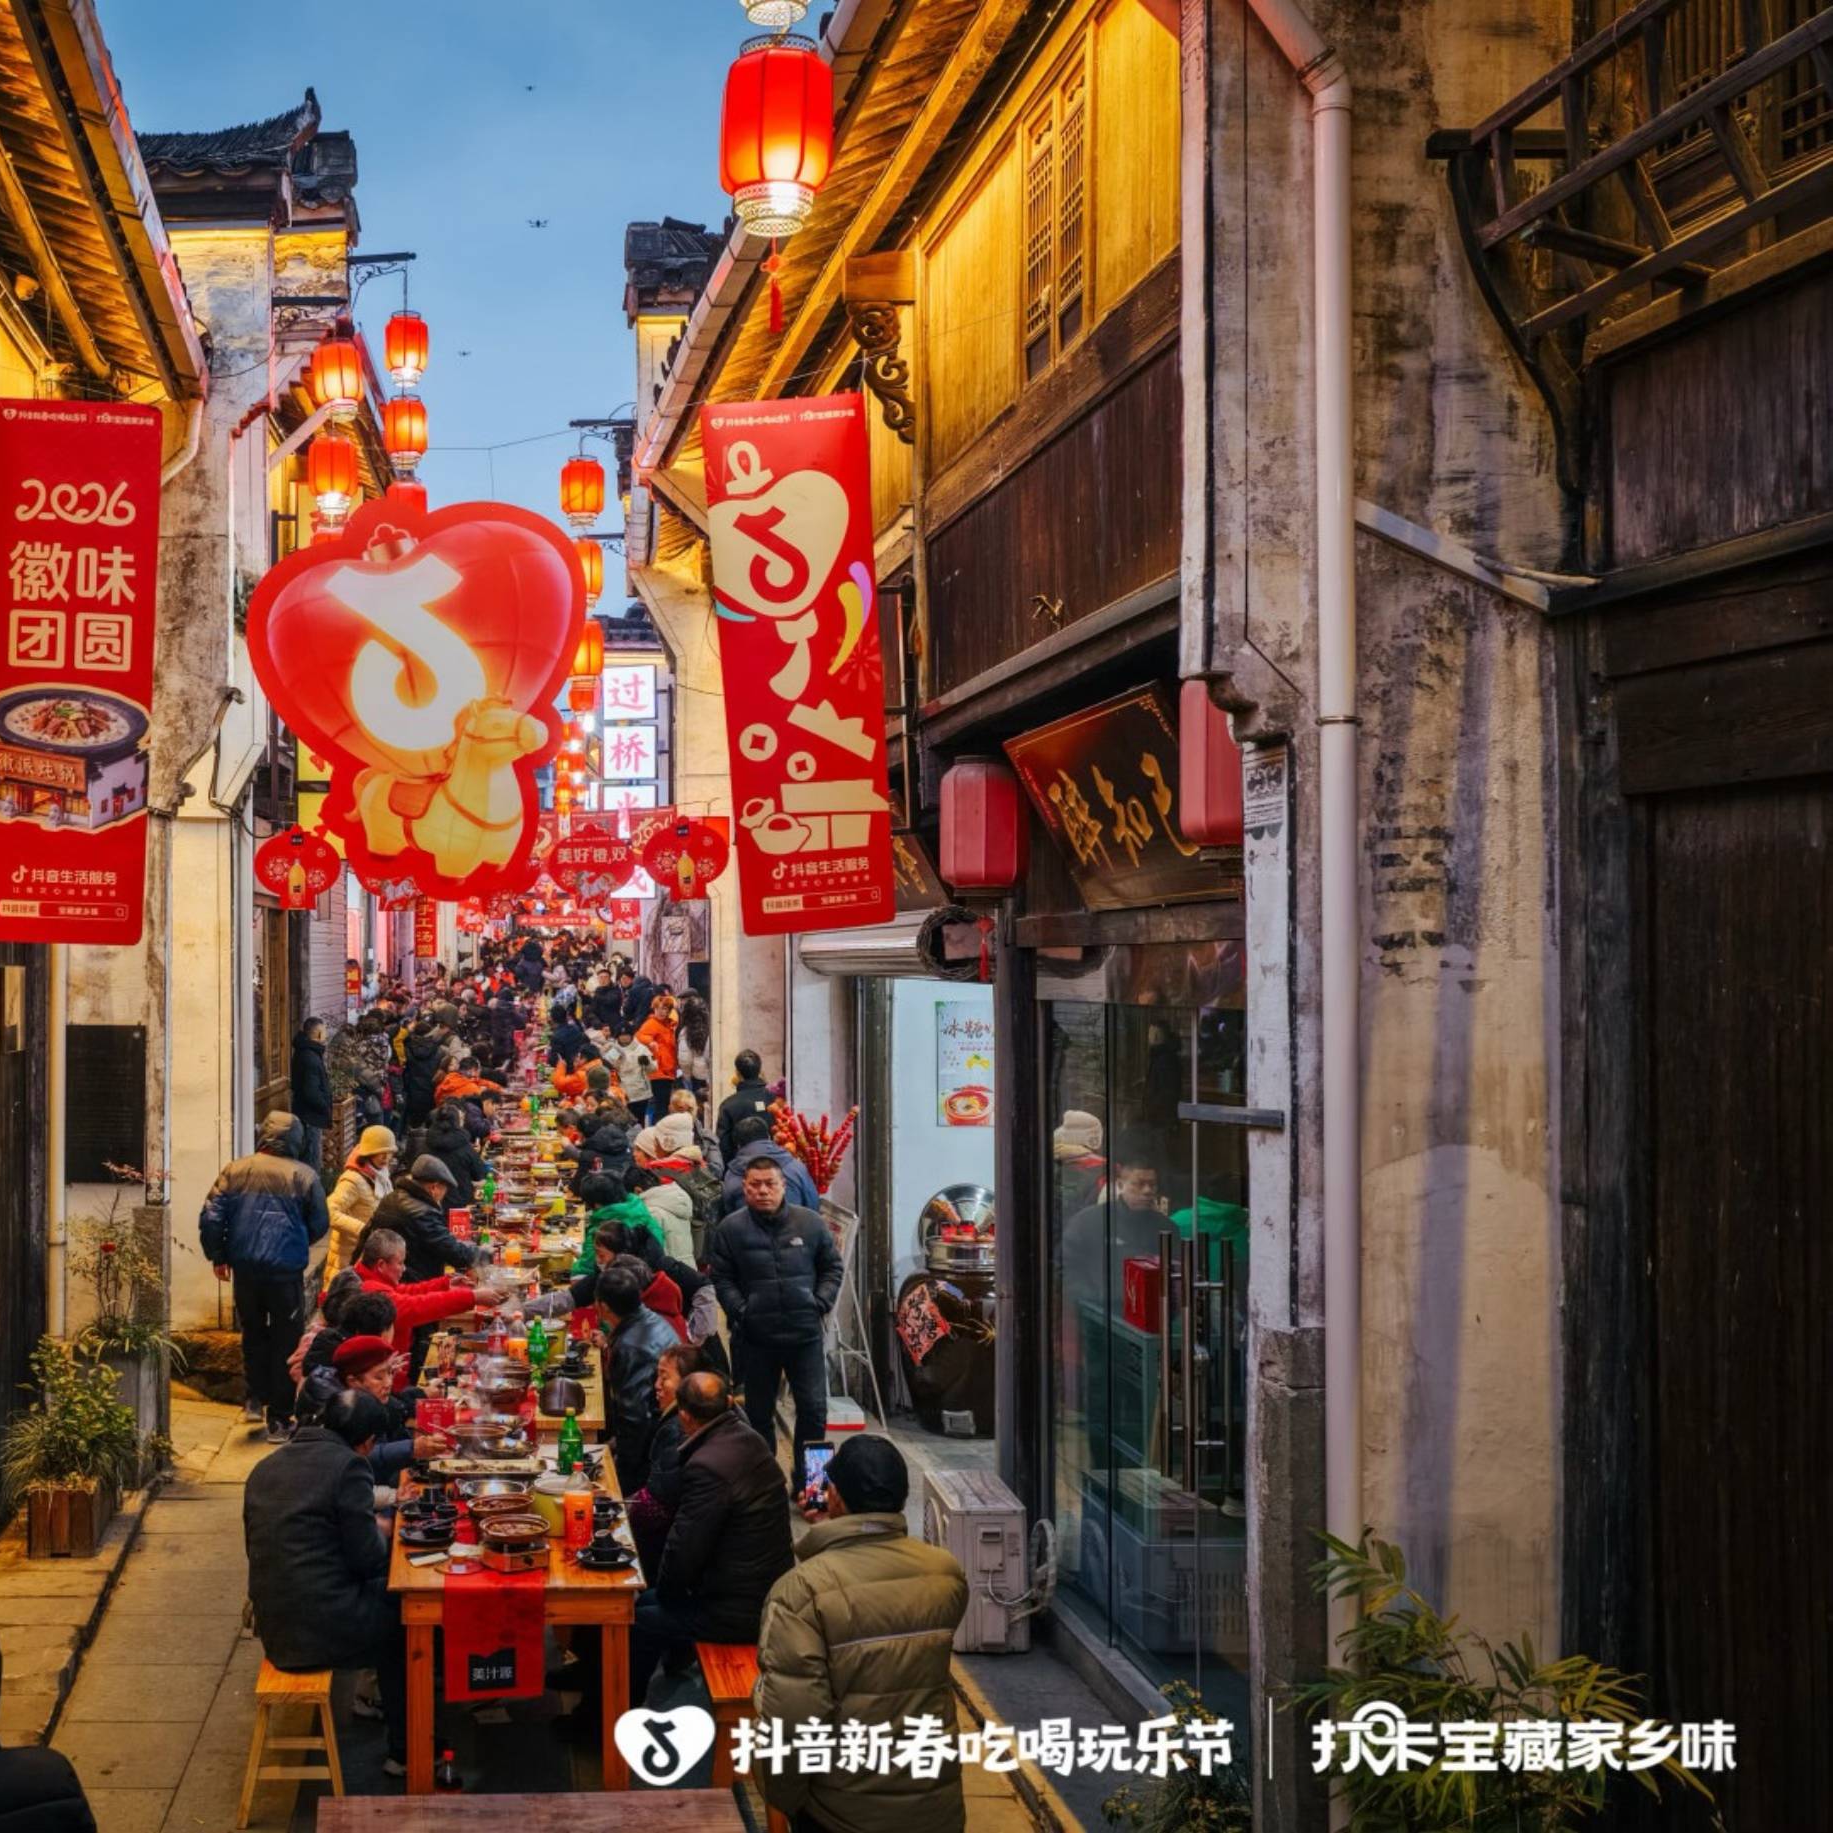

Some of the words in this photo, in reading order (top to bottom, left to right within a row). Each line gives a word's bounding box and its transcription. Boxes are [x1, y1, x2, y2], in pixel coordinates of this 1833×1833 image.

[14, 478, 137, 527] 2026
[8, 540, 137, 607] 徽味
[7, 608, 133, 673] 团圆
[31, 868, 118, 885] 抖音生活服务
